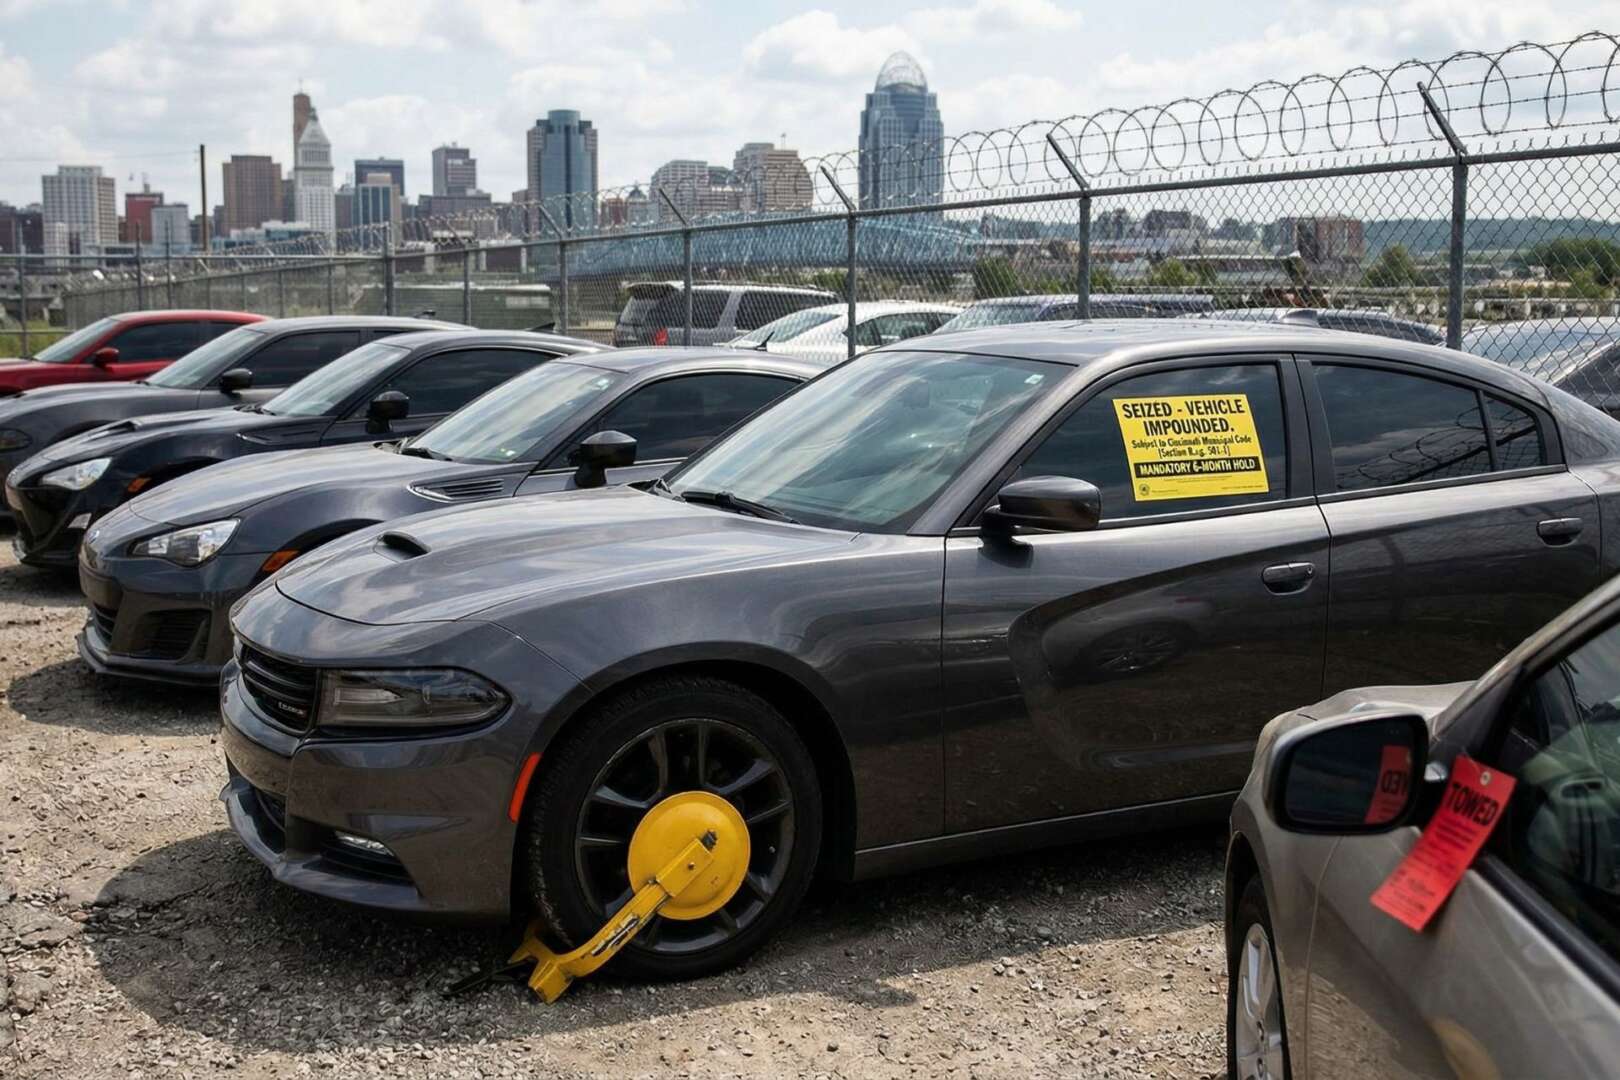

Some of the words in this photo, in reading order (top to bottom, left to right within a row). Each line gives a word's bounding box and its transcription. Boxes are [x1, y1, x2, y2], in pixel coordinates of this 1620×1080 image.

[1122, 402, 1172, 419] SEIZED
[1184, 399, 1246, 416] VEHICLE
[1143, 417, 1235, 436] IMPOUNDED.
[1140, 462, 1191, 475] MANDATORY
[1193, 460, 1231, 473] 6-MONTH
[1233, 458, 1256, 470] HOLD
[1446, 782, 1500, 826] TOWED
